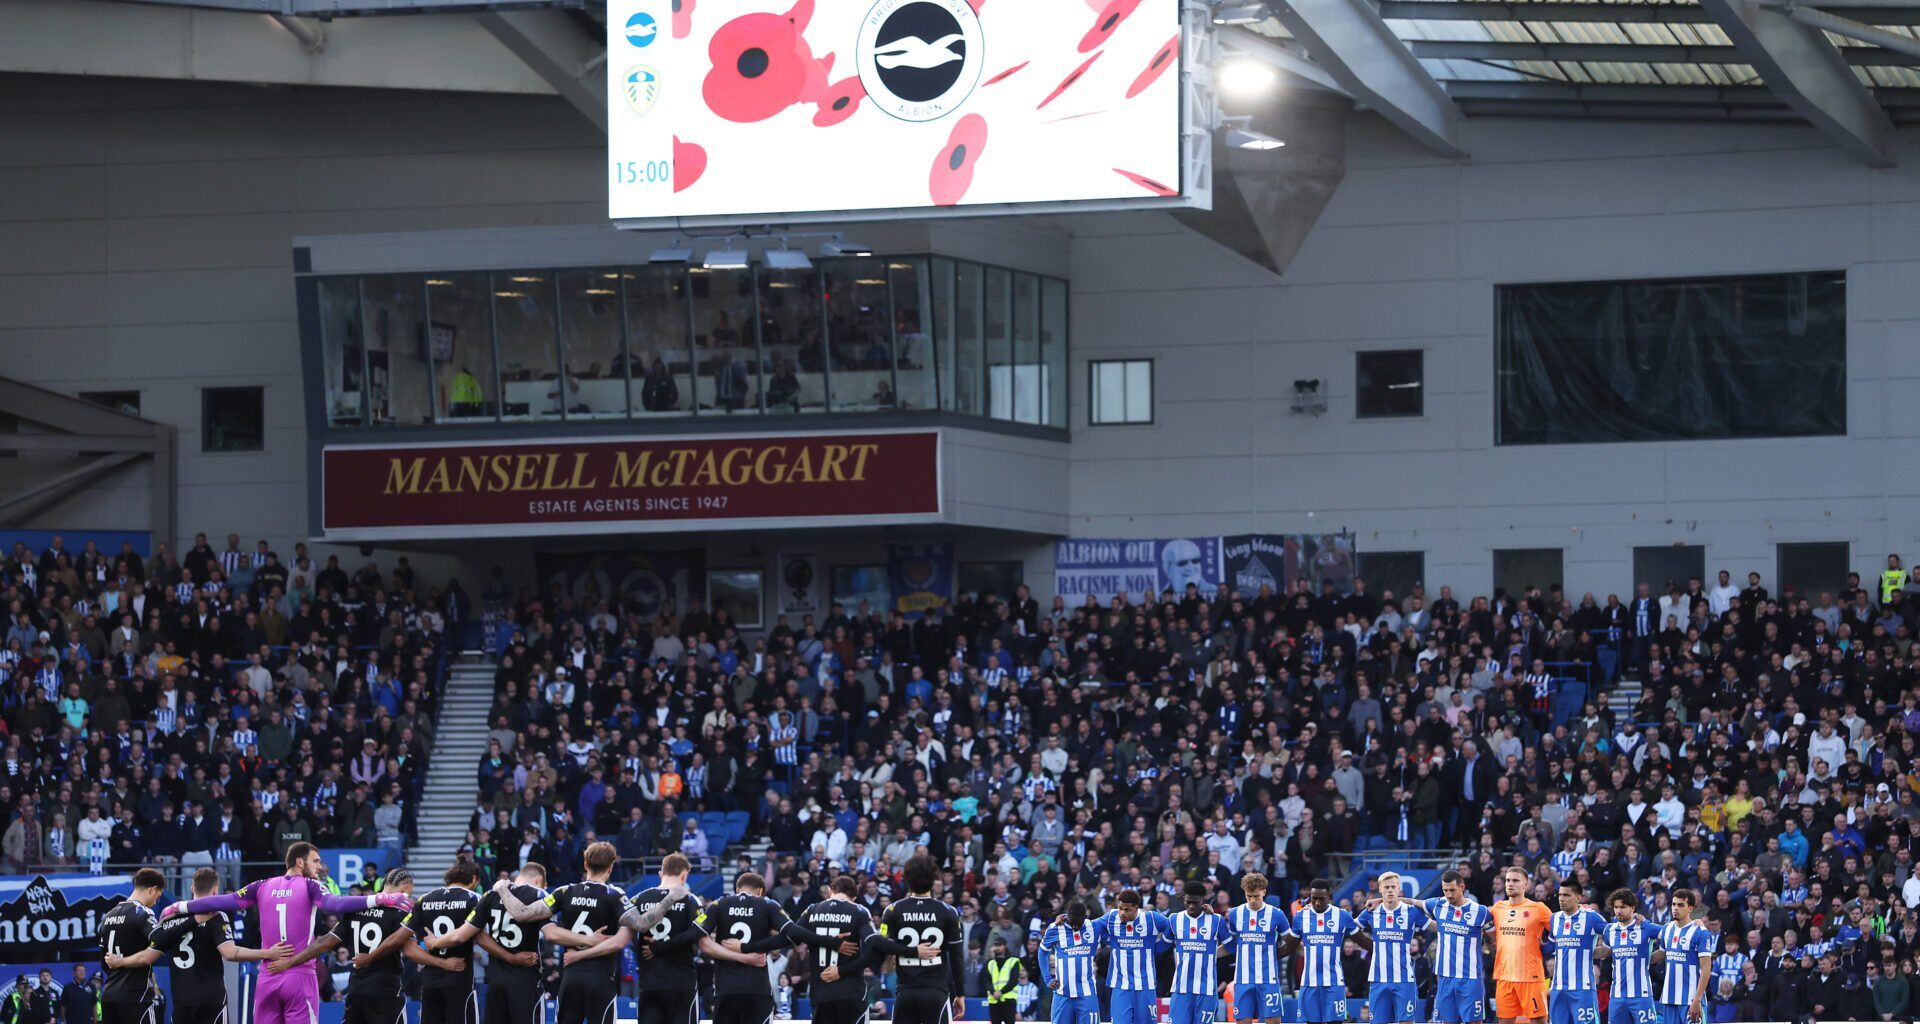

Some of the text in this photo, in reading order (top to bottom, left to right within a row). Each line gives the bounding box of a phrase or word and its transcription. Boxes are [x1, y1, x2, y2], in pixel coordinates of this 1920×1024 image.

[897, 104, 942, 117] ALBION
[616, 160, 669, 184] 15:00
[383, 444, 879, 494] MANSELL McTAGGART
[529, 496, 729, 514] ESTATE AGENTS SINCE 1947
[1058, 541, 1155, 564] ALBION OUI
[1058, 574, 1155, 594] RACISME NON
[338, 853, 364, 889] B
[271, 888, 293, 898] PERRI
[422, 900, 467, 911] CALVERT-LEWIN
[571, 896, 598, 908] RODON
[728, 906, 754, 917] BOGLE
[808, 912, 852, 924] AARONSON
[902, 912, 937, 923] TANAKA
[275, 903, 287, 942] 1
[491, 908, 523, 949] 15
[1441, 922, 1470, 932] AMERICAN
[1444, 927, 1469, 935] EXPRESS
[351, 920, 383, 957] 19
[173, 931, 195, 970] 3
[815, 927, 841, 967] 11
[898, 927, 944, 967] 22
[1265, 993, 1279, 1006] 27
[1531, 997, 1539, 1010] 1
[1148, 1004, 1157, 1017] 10
[1333, 1000, 1345, 1013] 18
[1406, 1000, 1414, 1013] 6
[1474, 1001, 1482, 1013] 5
[1089, 1012, 1098, 1022] 11
[1201, 1011, 1213, 1023] 17
[1577, 1007, 1595, 1021] 25
[1638, 1008, 1656, 1023] 24
